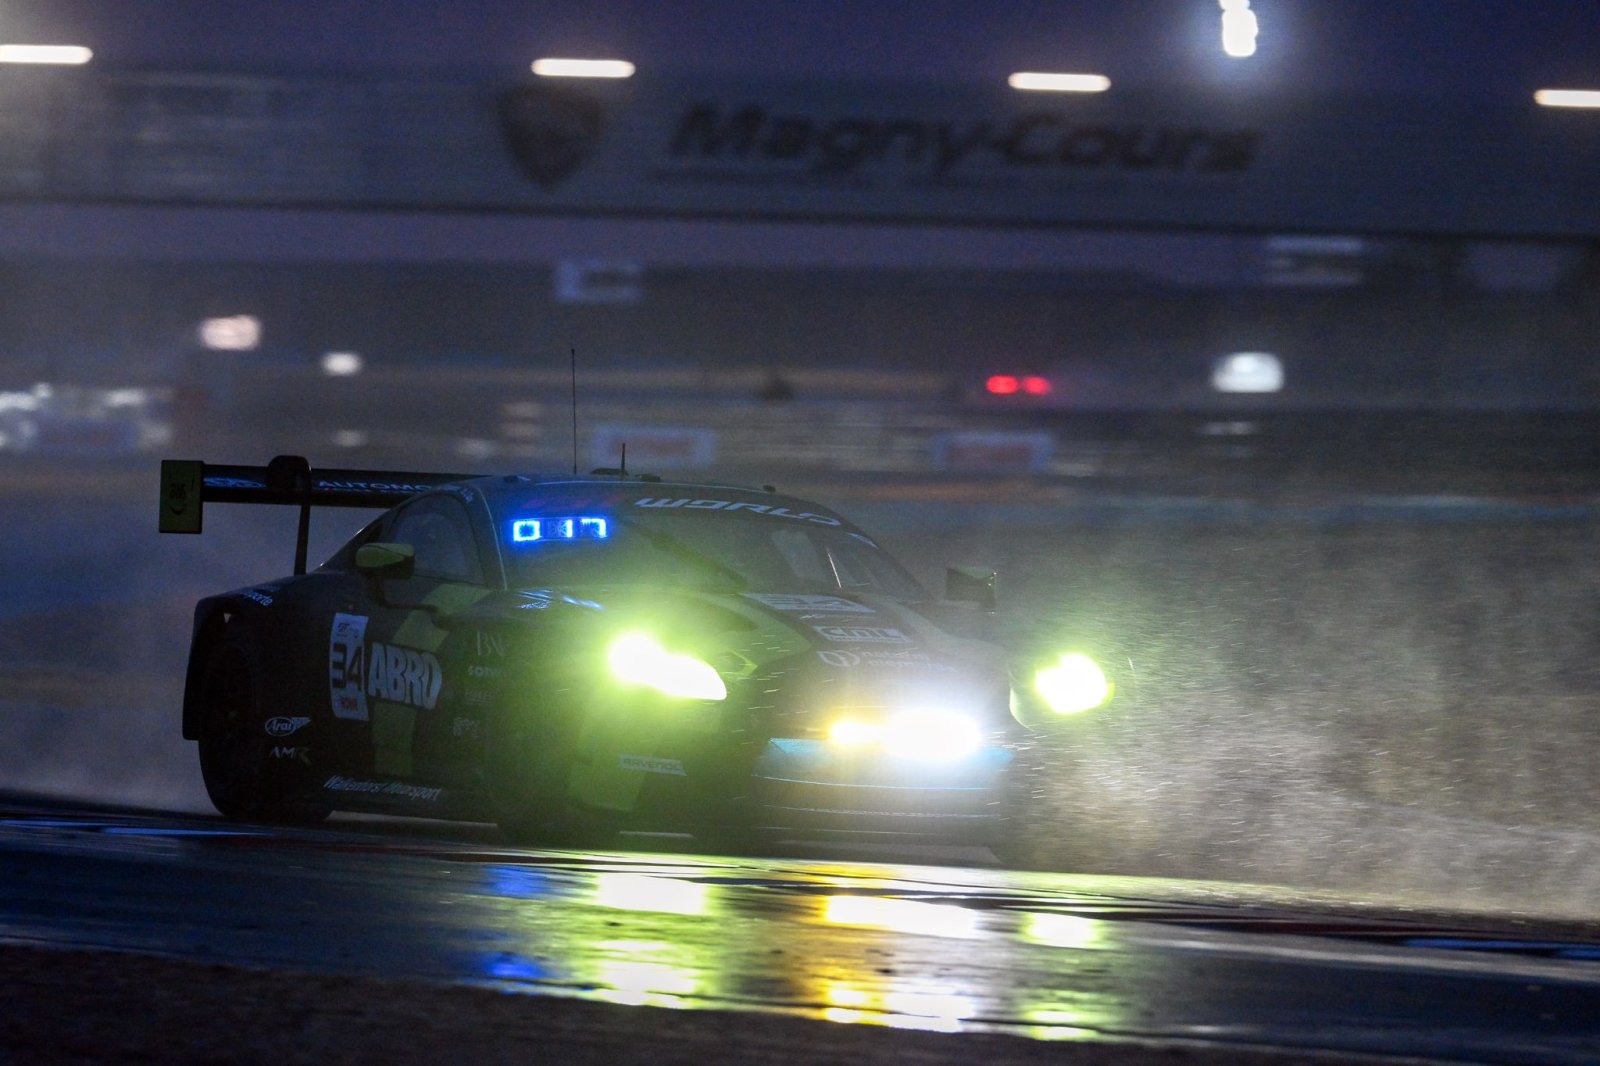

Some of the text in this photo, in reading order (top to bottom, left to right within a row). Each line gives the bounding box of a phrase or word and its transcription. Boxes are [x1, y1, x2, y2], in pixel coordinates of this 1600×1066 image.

[669, 105, 1256, 180] Magny-Cours
[319, 481, 432, 492] AUTOMO
[634, 497, 841, 527] WORLD
[331, 643, 362, 691] 34
[368, 641, 443, 710] ABRO
